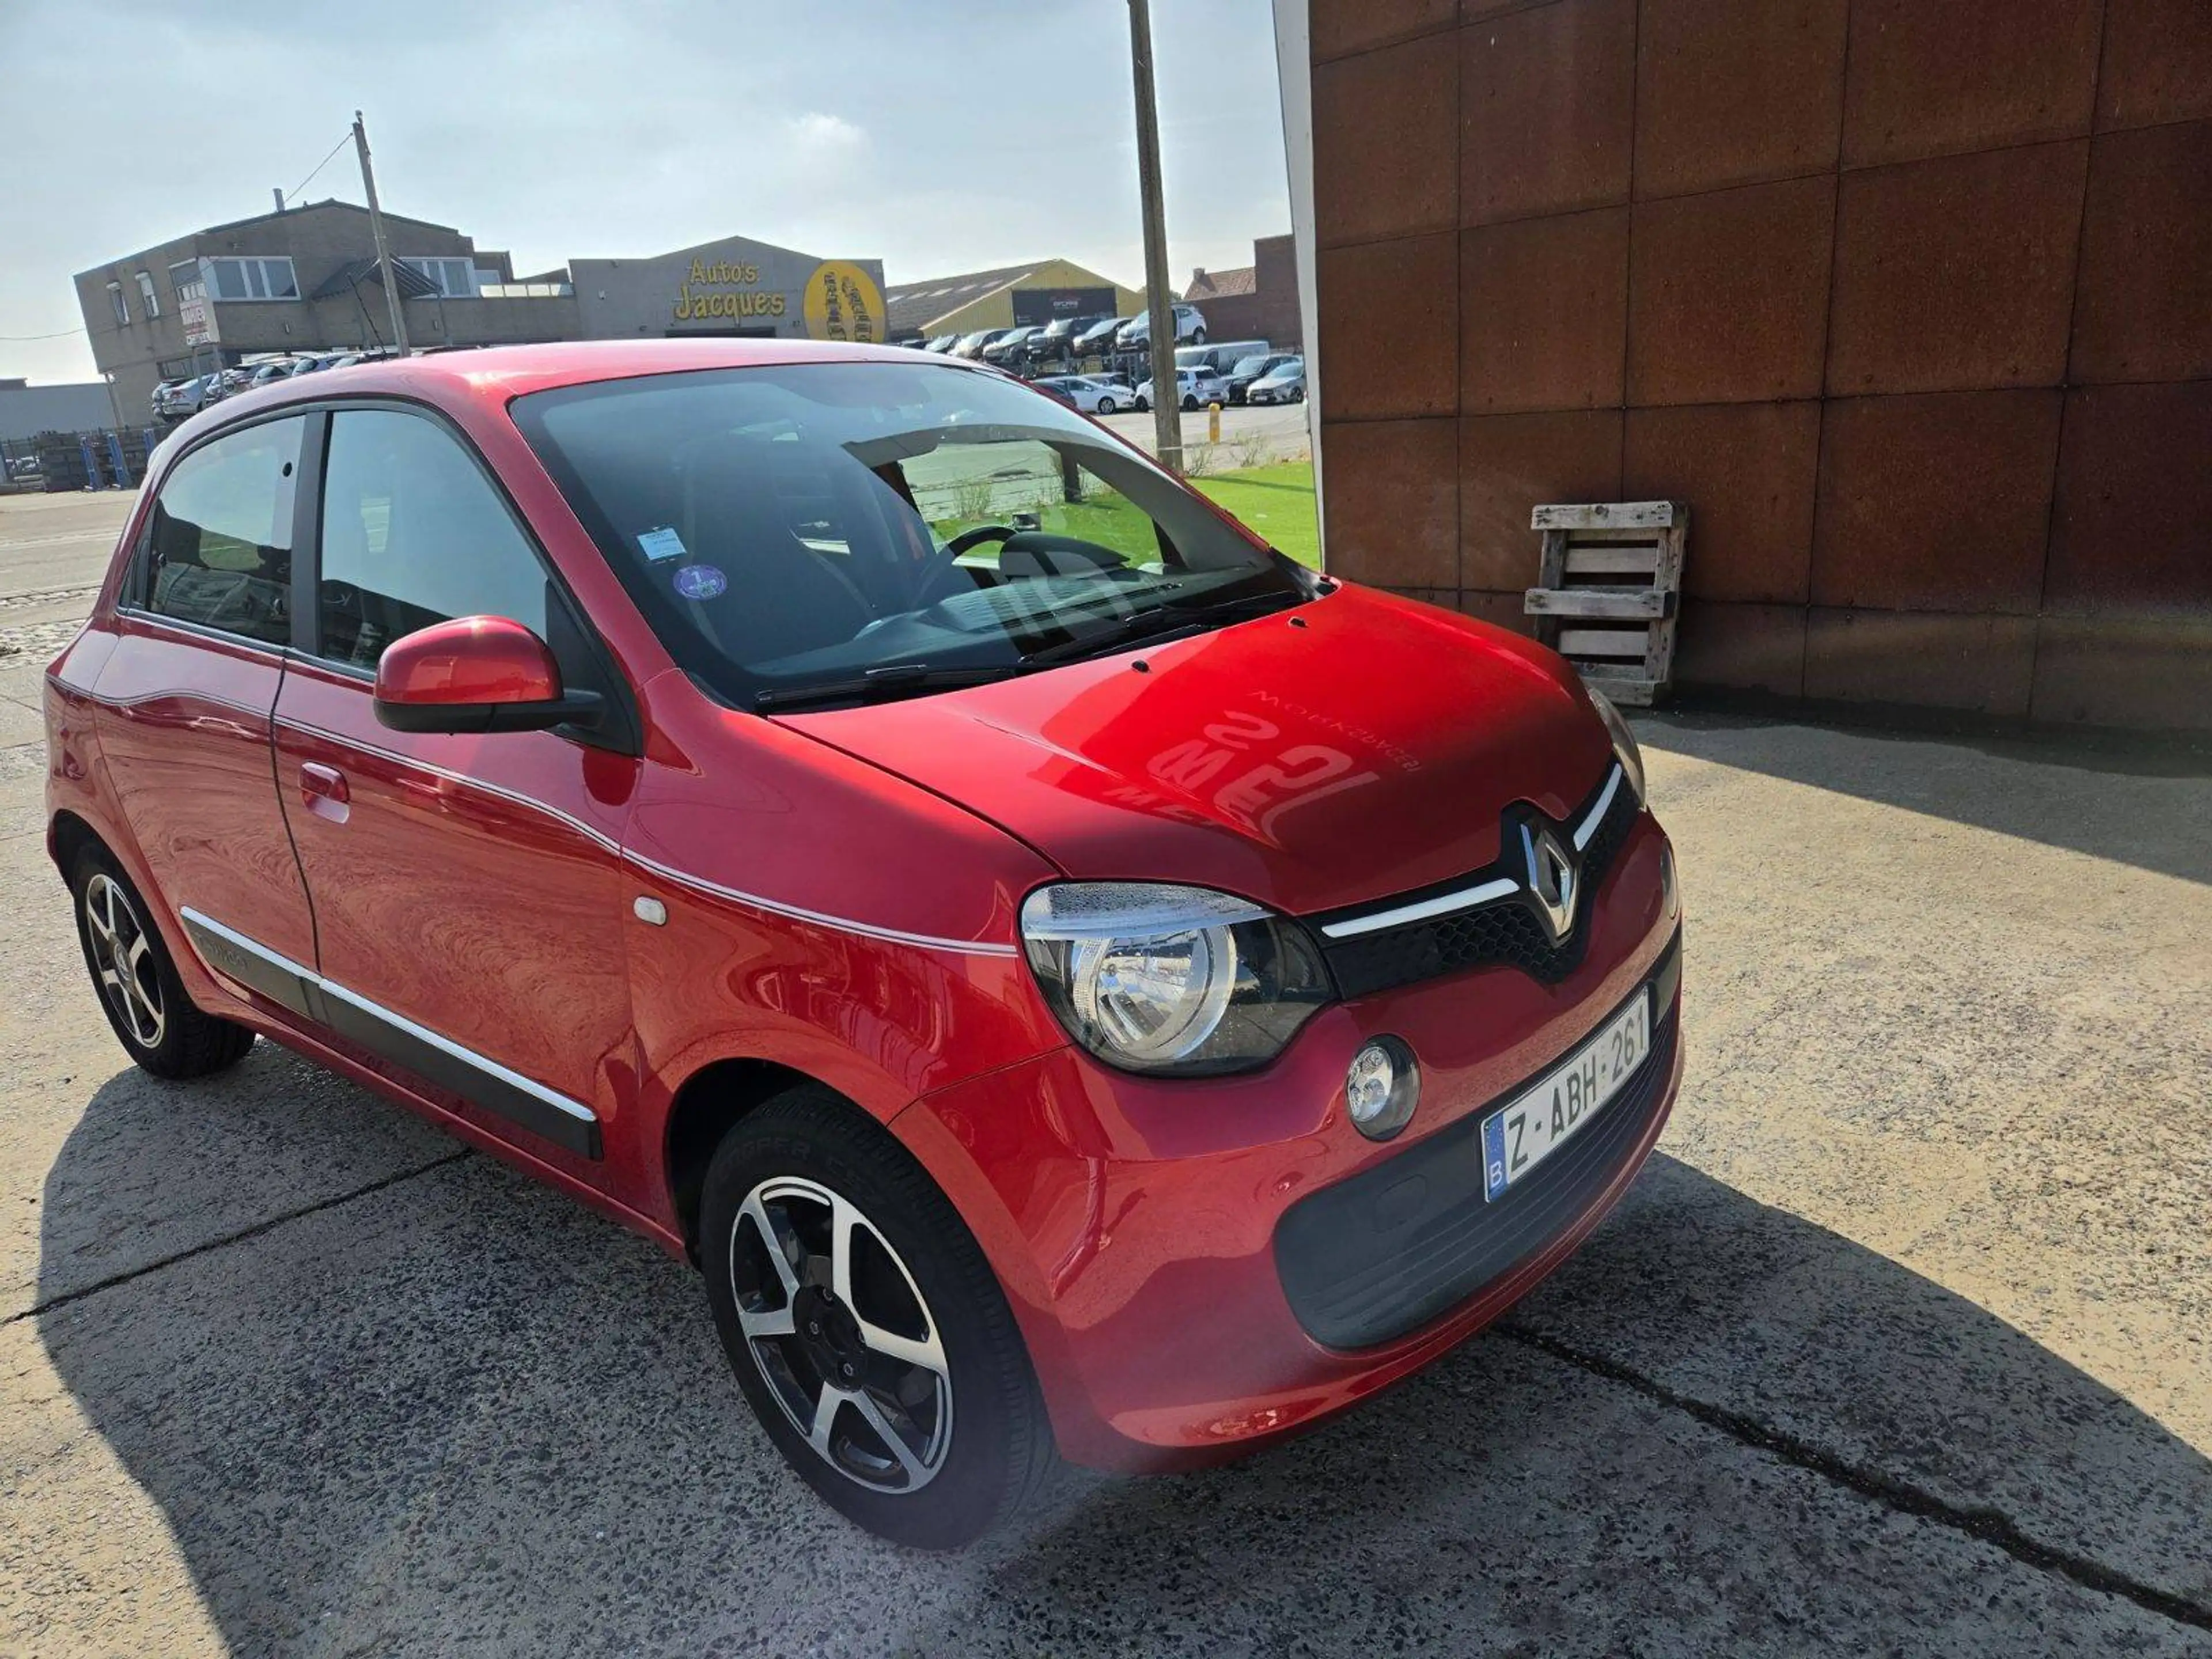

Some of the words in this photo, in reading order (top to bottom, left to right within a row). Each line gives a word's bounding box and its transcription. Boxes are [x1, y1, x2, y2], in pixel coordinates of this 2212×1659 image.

[690, 258, 758, 285] Auto's
[675, 284, 785, 327] Jacques
[1508, 1004, 1645, 1173] Z-ABH-261
[1489, 1160, 1503, 1187] B
